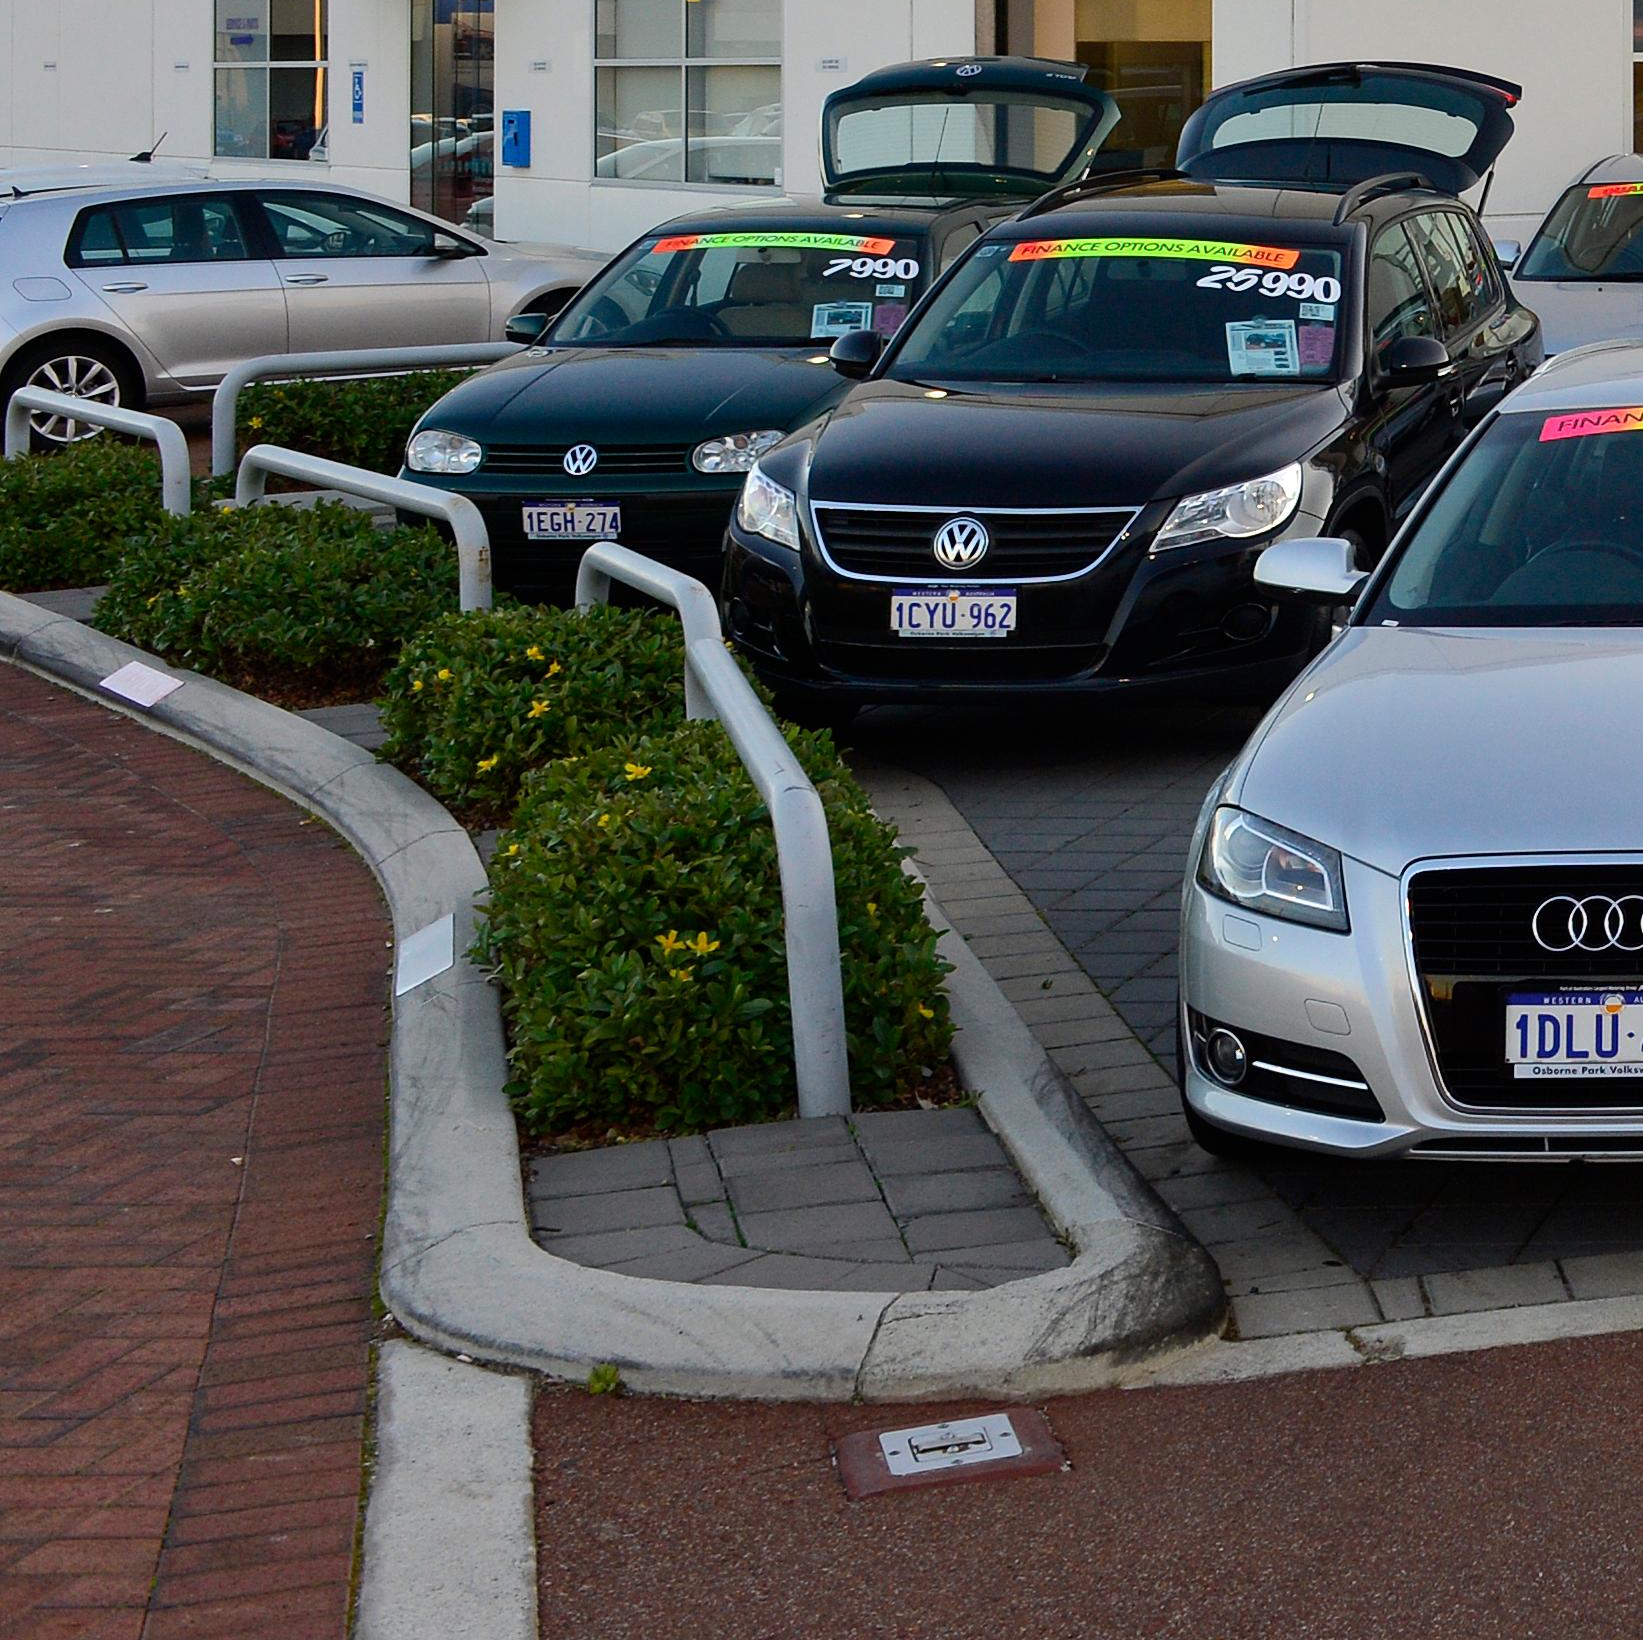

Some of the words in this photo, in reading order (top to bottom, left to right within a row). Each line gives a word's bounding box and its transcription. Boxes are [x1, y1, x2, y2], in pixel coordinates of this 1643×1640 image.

[664, 235, 729, 249] FINANCE
[731, 234, 798, 245] OPTIONS
[800, 235, 880, 250] AVAILABLE
[1021, 241, 1102, 255] FINANCE
[1104, 240, 1184, 253] OPTIONS
[1187, 243, 1285, 263] AVAILABLE
[822, 257, 919, 280] 7990
[1196, 265, 1341, 303] 25990
[1543, 997, 1591, 1005] WESTERN
[1532, 1066, 1577, 1075] Osborne
[1581, 1066, 1606, 1074] Park
